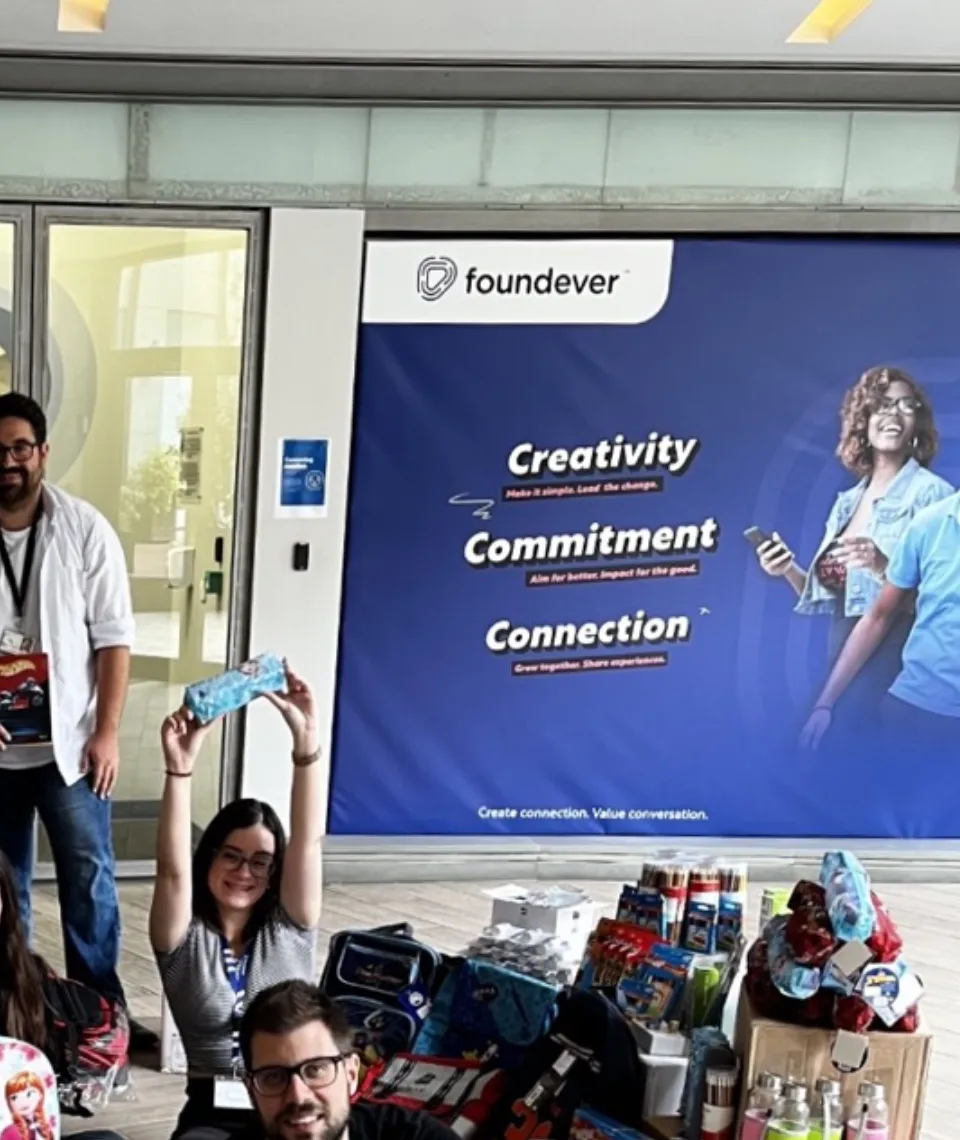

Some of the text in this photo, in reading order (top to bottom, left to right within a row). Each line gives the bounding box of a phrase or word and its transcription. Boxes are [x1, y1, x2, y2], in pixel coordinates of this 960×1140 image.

[465, 266, 620, 295] foundever
[507, 431, 699, 477] Creativity
[604, 482, 619, 491] the
[463, 517, 718, 565] Commitment
[529, 573, 550, 584] Aim
[652, 565, 668, 576] the
[485, 609, 690, 651] Connection
[478, 806, 709, 820] Create connection. Value conversation.
